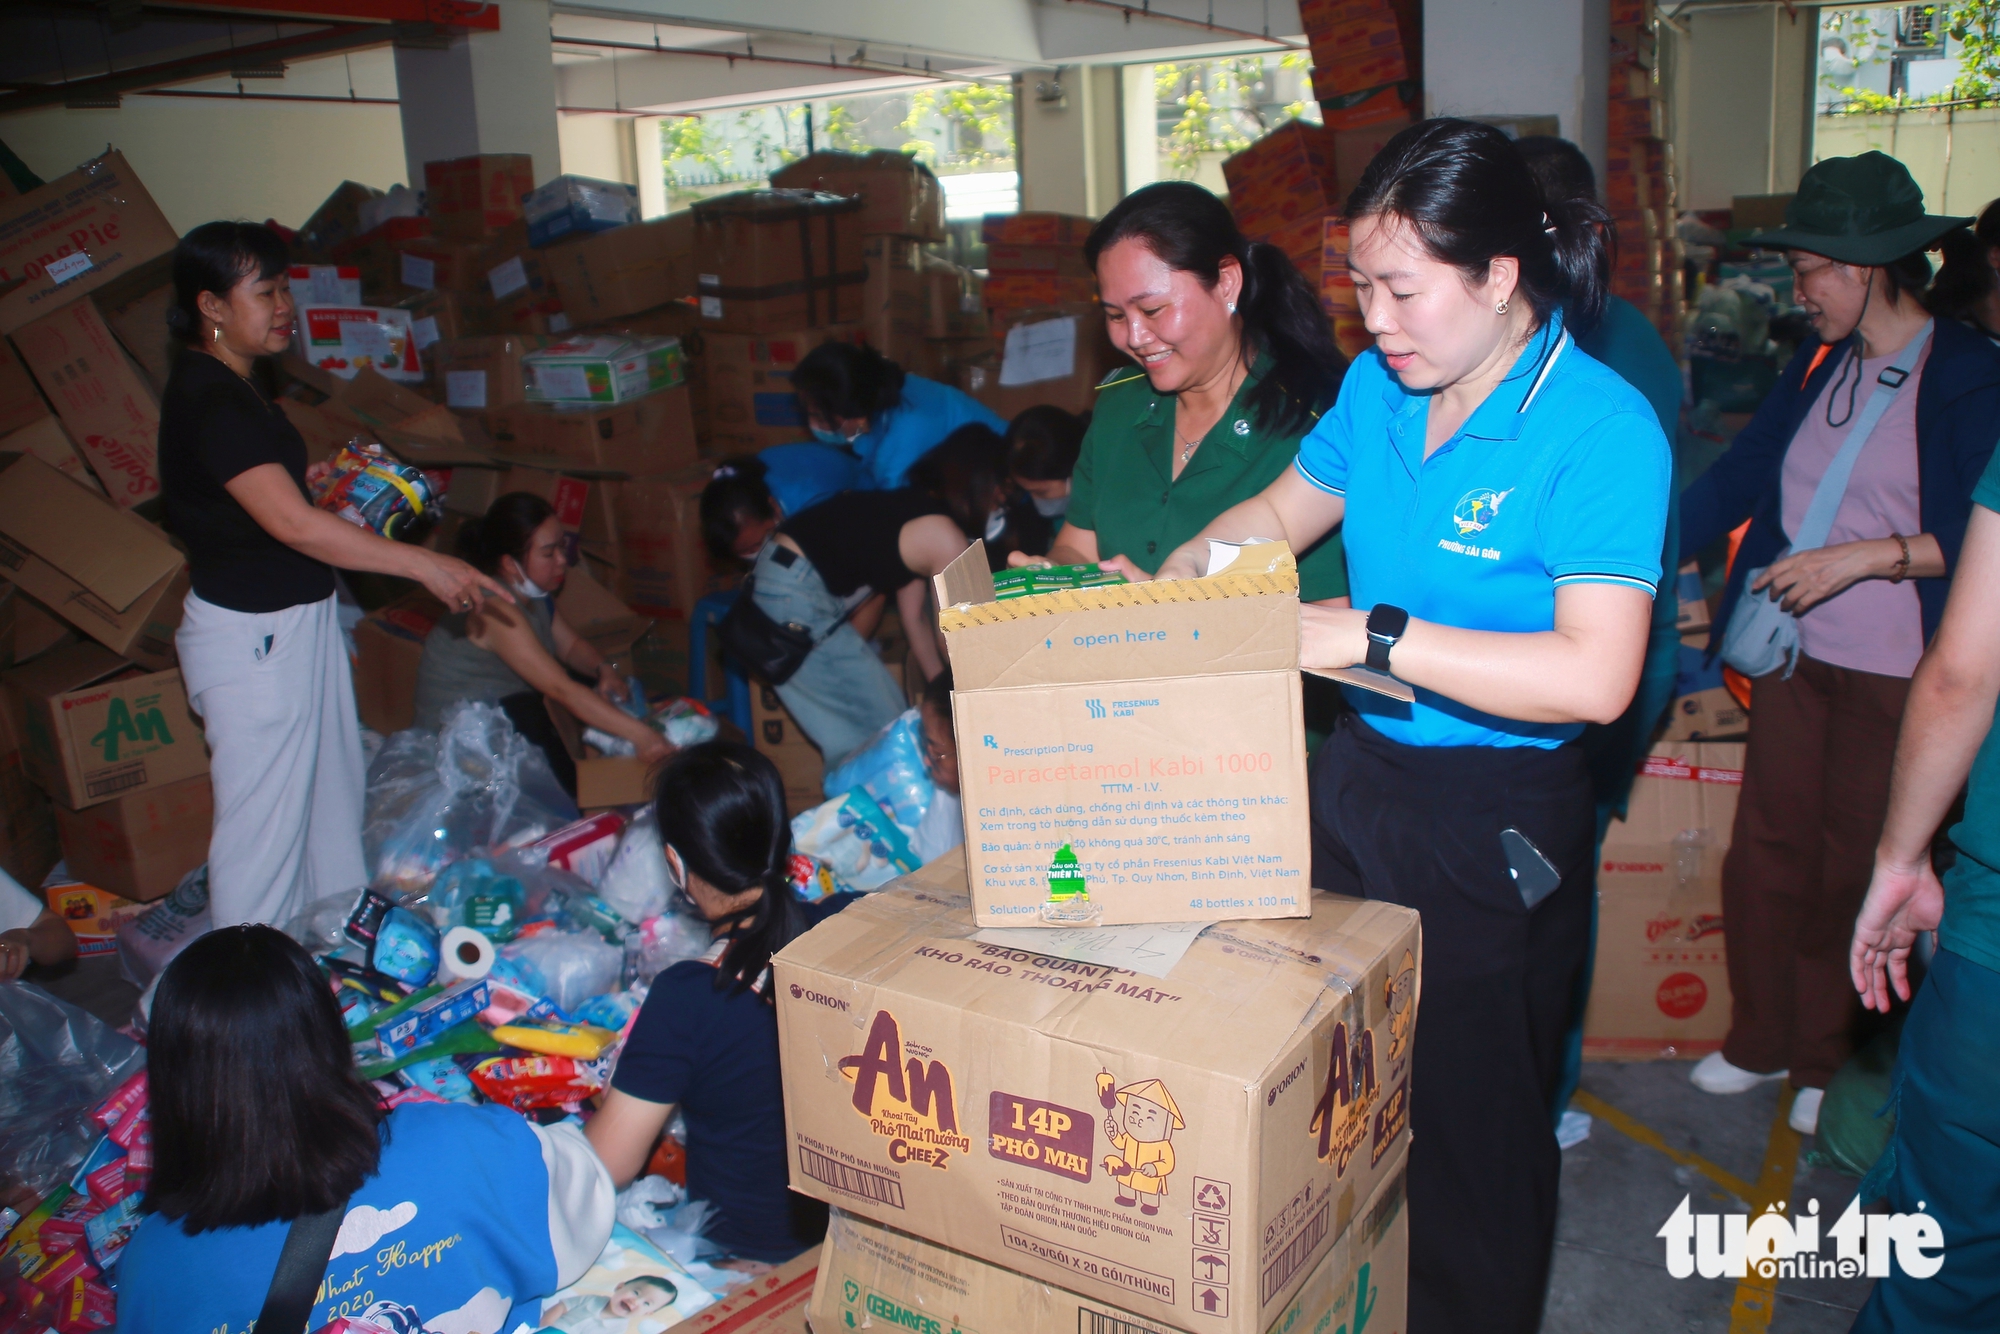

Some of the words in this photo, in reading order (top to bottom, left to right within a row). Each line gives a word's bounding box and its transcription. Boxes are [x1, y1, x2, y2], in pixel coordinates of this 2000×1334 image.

[1465, 545, 1480, 557] SÀI
[1482, 547, 1501, 560] GÒN
[1073, 631, 1120, 649] open
[1125, 627, 1167, 643] here
[1112, 699, 1159, 708] FRESENIUS
[1113, 709, 1134, 718] KABI
[1004, 745, 1065, 757] Prescription
[1067, 743, 1094, 752] Drug
[988, 758, 1140, 785] Paracetamol
[1149, 755, 1204, 777] Kabi
[1215, 752, 1273, 774] 1000
[1101, 783, 1133, 794] TTTM
[1144, 782, 1162, 792] I.V.
[999, 807, 1025, 817] định,
[1029, 805, 1052, 815] cách
[1056, 804, 1085, 814] dùng,
[1089, 801, 1122, 813] chống
[1144, 800, 1167, 811] định
[1171, 800, 1183, 808] và
[1187, 799, 1203, 808] các
[1206, 797, 1239, 808] thông
[1242, 797, 1257, 806] tin
[1260, 795, 1288, 805] khác:
[980, 822, 1004, 831] Xem
[1007, 822, 1036, 831] trong
[1054, 819, 1088, 829] hướng
[1129, 815, 1158, 826] dụng
[1161, 814, 1191, 824] thuốc
[1195, 813, 1217, 822] kèm
[1221, 812, 1246, 821] theo
[981, 842, 1000, 852] Bảo
[1089, 838, 1121, 848] không
[1124, 838, 1143, 847] quá
[1174, 835, 1201, 844] tránh
[1205, 834, 1223, 843] ánh
[1227, 834, 1250, 844] sáng
[984, 864, 998, 873] Cơ
[1095, 861, 1104, 870] ty
[1123, 859, 1150, 870] phần
[1153, 857, 1202, 867] Fresenius
[1205, 856, 1229, 865] Kabi
[1232, 855, 1254, 865] Việt
[1258, 855, 1282, 863] Nam
[1047, 869, 1071, 879] THIÊN
[985, 878, 1005, 887] Khu
[1009, 879, 1026, 888] vực
[1029, 877, 1038, 886] 8,
[1086, 875, 1109, 884] Phú,
[1112, 874, 1127, 884] Tp.
[1131, 873, 1153, 884] Quy
[1156, 873, 1188, 882] Nhơn,
[1192, 870, 1215, 880] Bình
[1218, 869, 1247, 880] Định,
[1250, 869, 1272, 878] Việt
[1275, 868, 1300, 877] Nam
[989, 904, 1036, 915] Solution
[1190, 899, 1203, 908] 48
[1206, 898, 1244, 908] bottles
[1258, 897, 1277, 906] 100
[1280, 896, 1297, 905] mL
[1239, 950, 1281, 965] ORION
[914, 946, 963, 963] KHÔ
[964, 958, 1012, 978] RÁO,
[1019, 968, 1114, 992] THOÁNG
[806, 989, 847, 1012] ORION
[837, 1009, 958, 1136] An
[1278, 1057, 1308, 1094] ORION
[881, 1108, 904, 1122] Khoai
[904, 1112, 919, 1126] Tây
[1012, 1101, 1072, 1140] 14P
[870, 1118, 894, 1136] Phô
[893, 1123, 923, 1143] Mai
[923, 1130, 970, 1153] Nướng
[797, 1132, 803, 1143] VỊ
[805, 1136, 824, 1151] KHOAI
[826, 1146, 838, 1157] TÂY
[840, 1151, 855, 1164] PHÔ
[857, 1158, 871, 1169] MAI
[873, 1163, 900, 1179] NƯỚNG
[889, 1138, 951, 1170] CHEE-Z
[992, 1133, 1040, 1160] PHÔ
[1044, 1146, 1088, 1176] MAI
[1000, 1191, 1019, 1203] THEO
[1021, 1196, 1035, 1207] BẢN
[1037, 1201, 1061, 1215] QUYỀN
[1062, 1209, 1091, 1225] THƯƠNG
[1092, 1218, 1109, 1231] HIỆU
[1111, 1223, 1134, 1238] ORION
[1135, 1231, 1150, 1243] CỦA
[1001, 1179, 1015, 1189] SẢN
[1016, 1182, 1033, 1193] XUẤT
[1034, 1187, 1044, 1197] TẠI
[1045, 1190, 1063, 1203] CÔNG
[1064, 1197, 1072, 1206] TY
[1074, 1200, 1092, 1212] TNHH
[1093, 1206, 1111, 1218] THỰC
[1112, 1211, 1132, 1224] PHẨM
[1133, 1219, 1155, 1231] ORION
[1156, 1225, 1173, 1236] VINA
[1000, 1202, 1013, 1213] TẬP
[1014, 1207, 1034, 1219] ĐOÀN
[1036, 1214, 1059, 1228] ORION,
[1060, 1220, 1075, 1231] HÀN
[1077, 1225, 1097, 1238] QUỐC
[328, 1222, 371, 1244] Happen
[1285, 1225, 1294, 1241] TÂY
[304, 1250, 327, 1267] 2020
[925, 1274, 967, 1296] MANUFACTURED
[1072, 1257, 1080, 1268] X
[1083, 1261, 1098, 1274] 20
[1101, 1267, 1171, 1298] GÓI/THÙNG
[866, 1293, 941, 1334] SEAWEED
